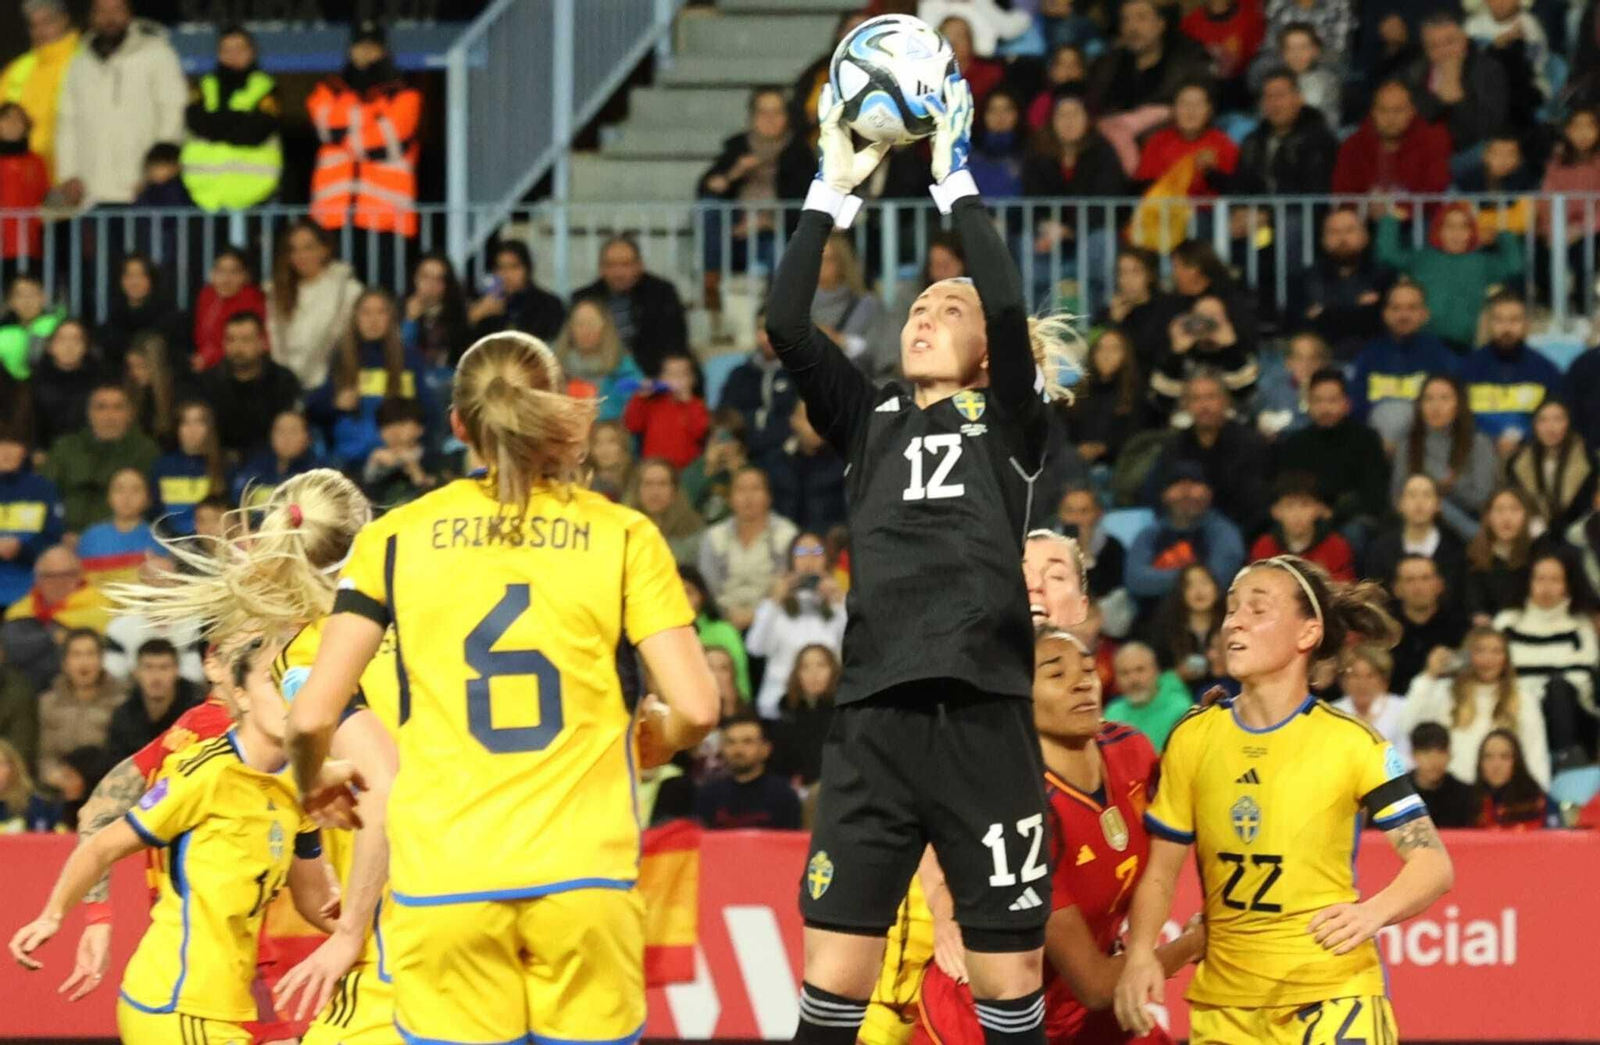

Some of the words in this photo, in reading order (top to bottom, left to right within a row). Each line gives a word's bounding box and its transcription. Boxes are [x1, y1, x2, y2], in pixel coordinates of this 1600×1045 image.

[903, 433, 966, 501] 12
[464, 583, 565, 755] 6
[982, 812, 1048, 887] 12
[1217, 852, 1283, 913] 22
